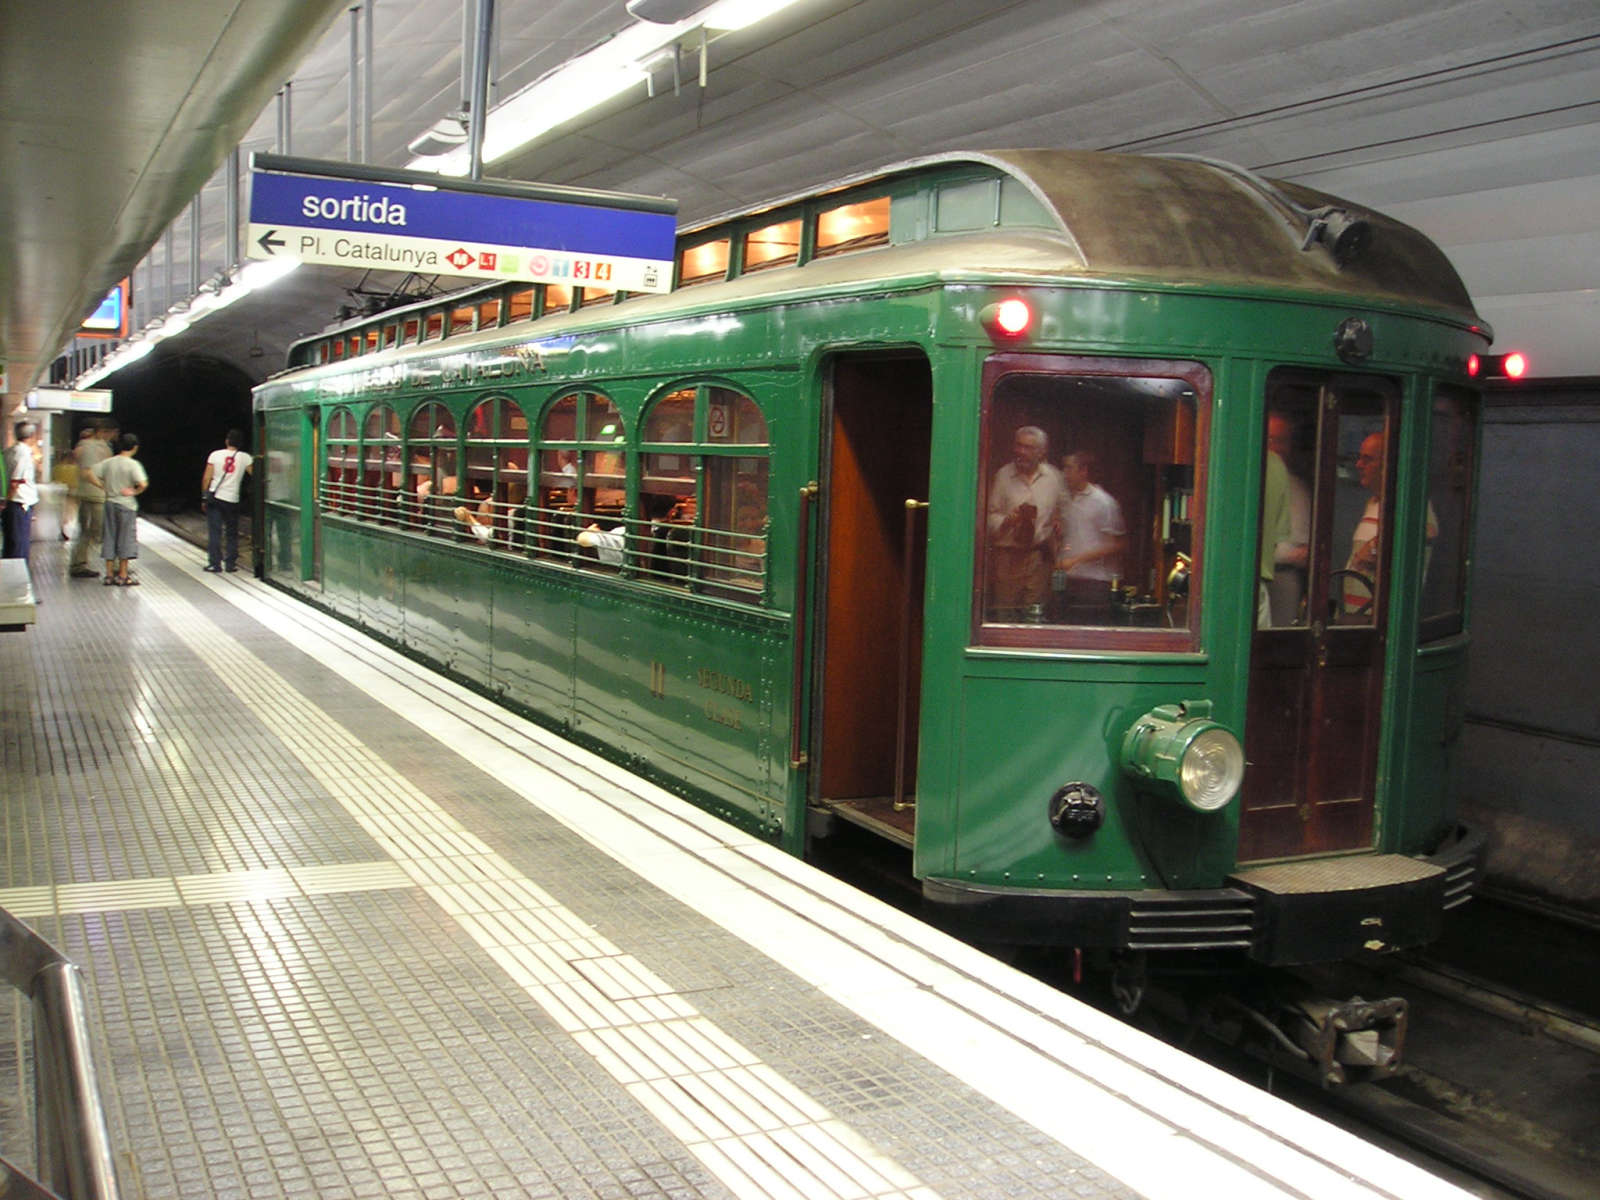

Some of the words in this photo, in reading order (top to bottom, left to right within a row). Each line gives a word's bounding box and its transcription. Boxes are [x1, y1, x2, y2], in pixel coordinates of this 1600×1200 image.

[302, 194, 407, 226] sortida
[300, 235, 326, 256] Pl.
[334, 238, 438, 268] Catalunya
[479, 253, 495, 269] L1
[224, 456, 236, 473] 8
